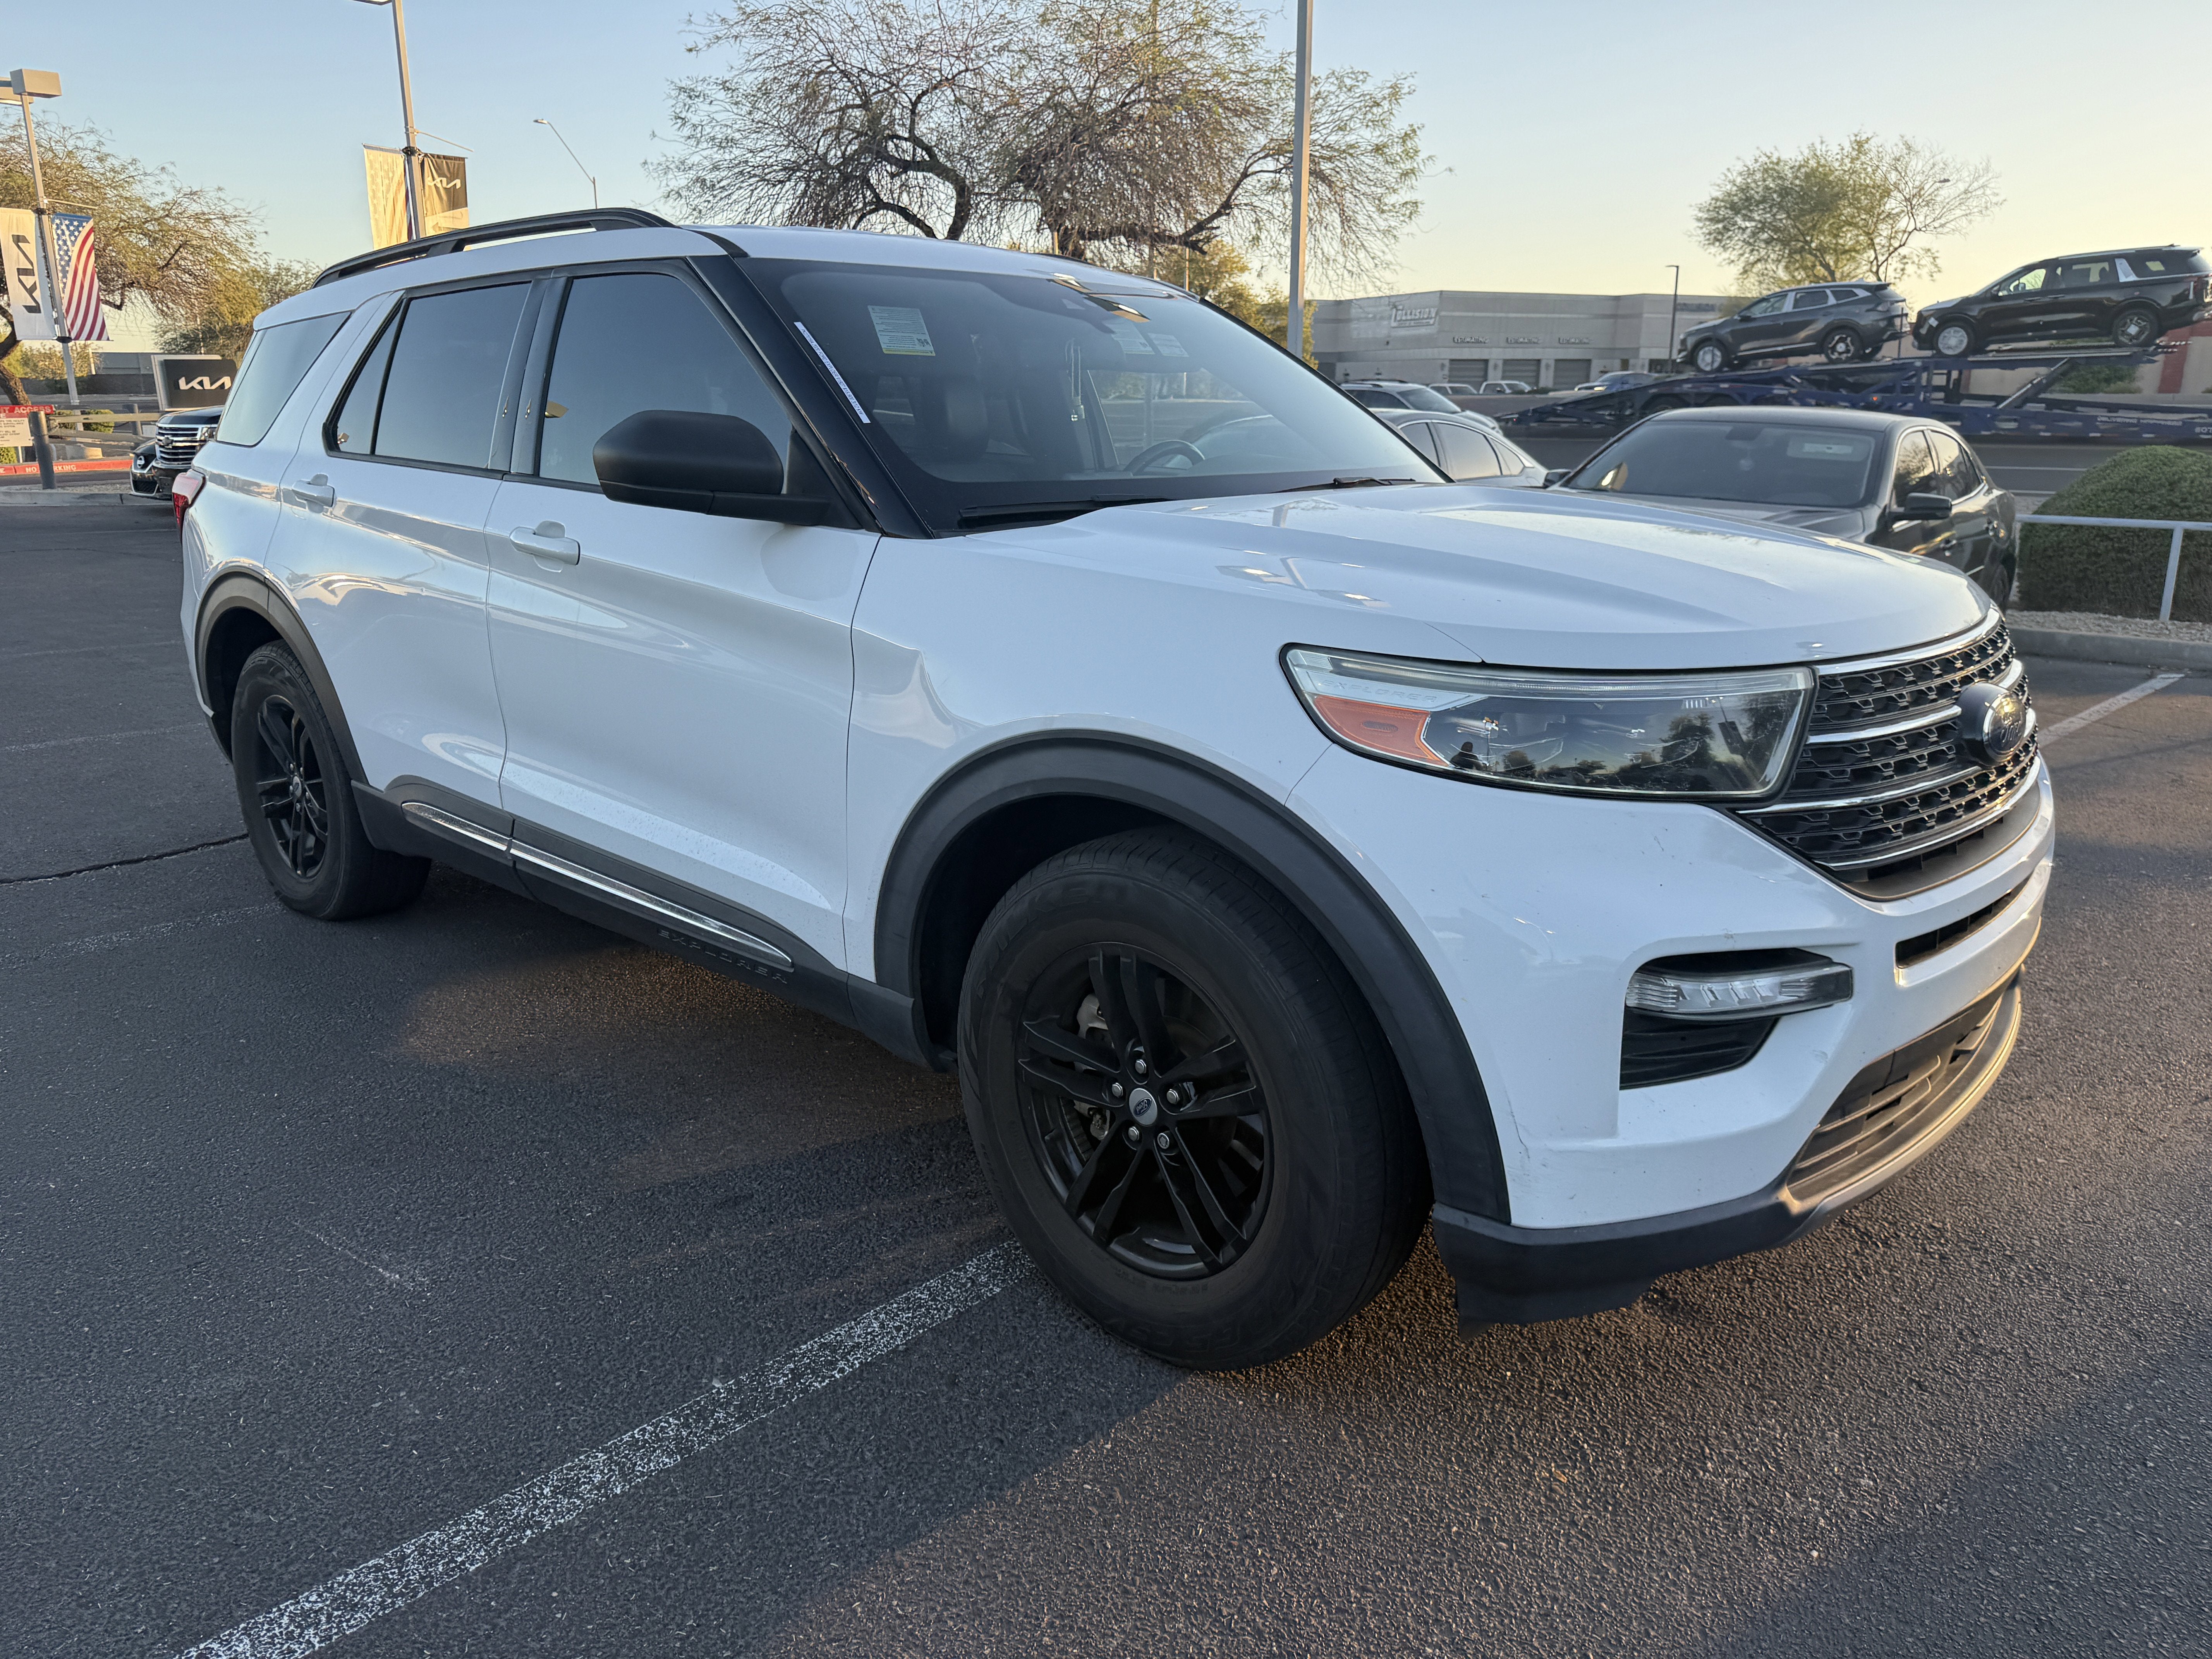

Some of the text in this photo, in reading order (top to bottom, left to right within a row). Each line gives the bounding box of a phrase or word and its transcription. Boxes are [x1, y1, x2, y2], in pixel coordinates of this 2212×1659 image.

[12, 234, 41, 313] KIA
[179, 376, 231, 390] KIA
[1321, 680, 1437, 702] EXPLORER
[658, 930, 788, 984] EXPLORER
[1136, 1099, 1148, 1115] Ford
